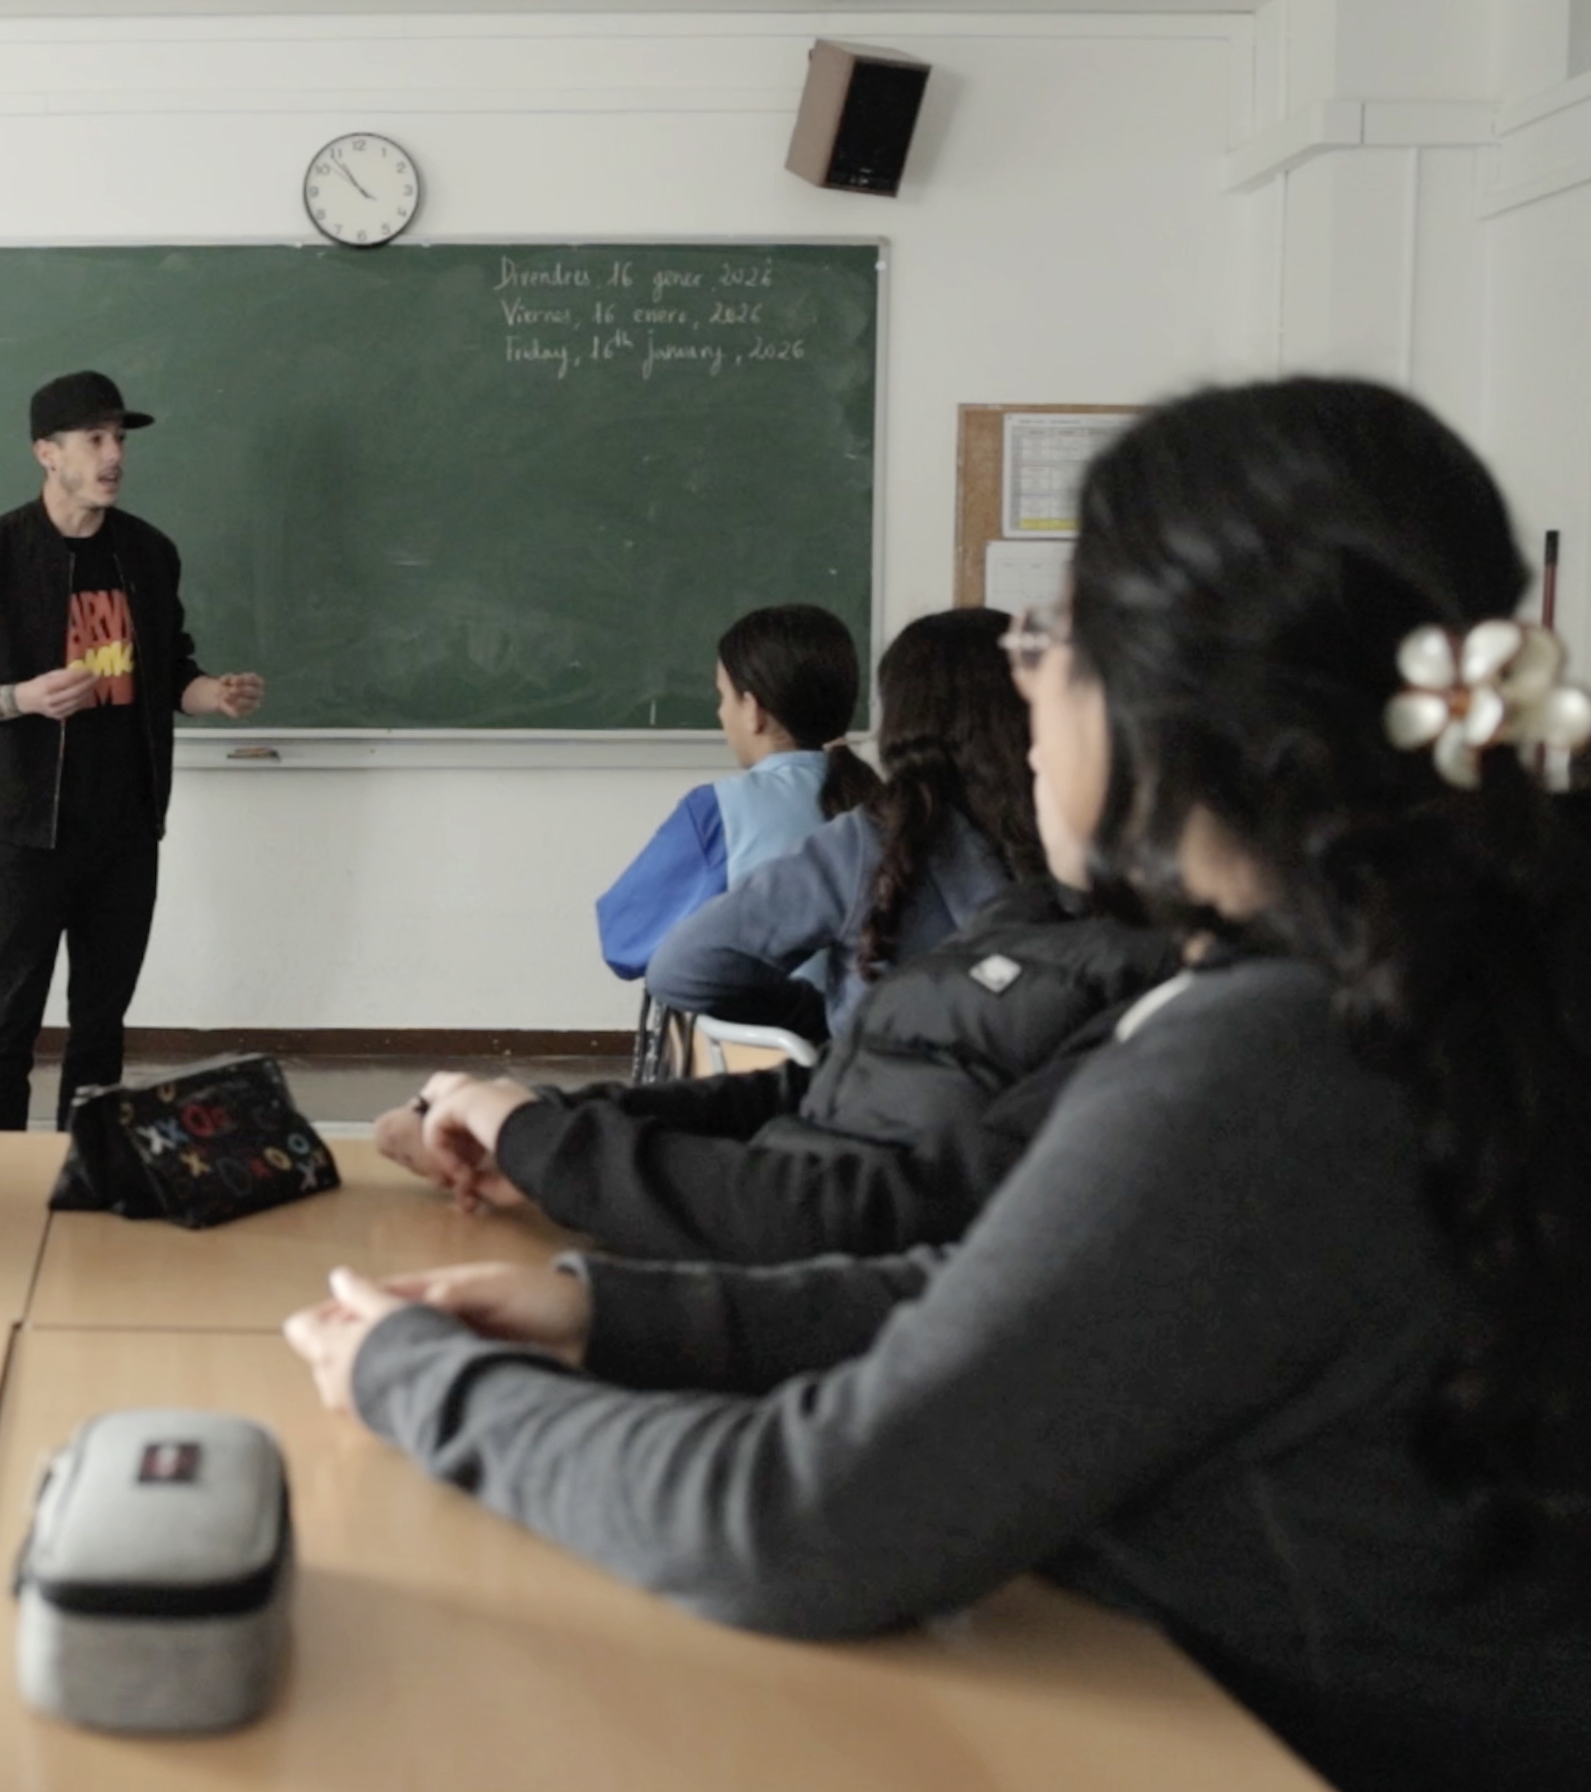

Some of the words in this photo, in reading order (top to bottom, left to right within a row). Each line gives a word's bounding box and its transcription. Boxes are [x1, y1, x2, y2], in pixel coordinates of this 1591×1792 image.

[352, 140, 367, 151] 12
[315, 163, 331, 176] 10
[396, 162, 407, 174] 2
[309, 186, 320, 198] 9
[403, 184, 414, 197] 3
[316, 208, 326, 220] 8
[397, 207, 407, 218] 4
[334, 223, 343, 236] 7
[381, 222, 391, 235] 5
[357, 230, 367, 242] 6
[606, 260, 633, 287] 16
[591, 302, 616, 324] 16
[709, 301, 763, 324] 2026
[749, 335, 805, 360] 2026
